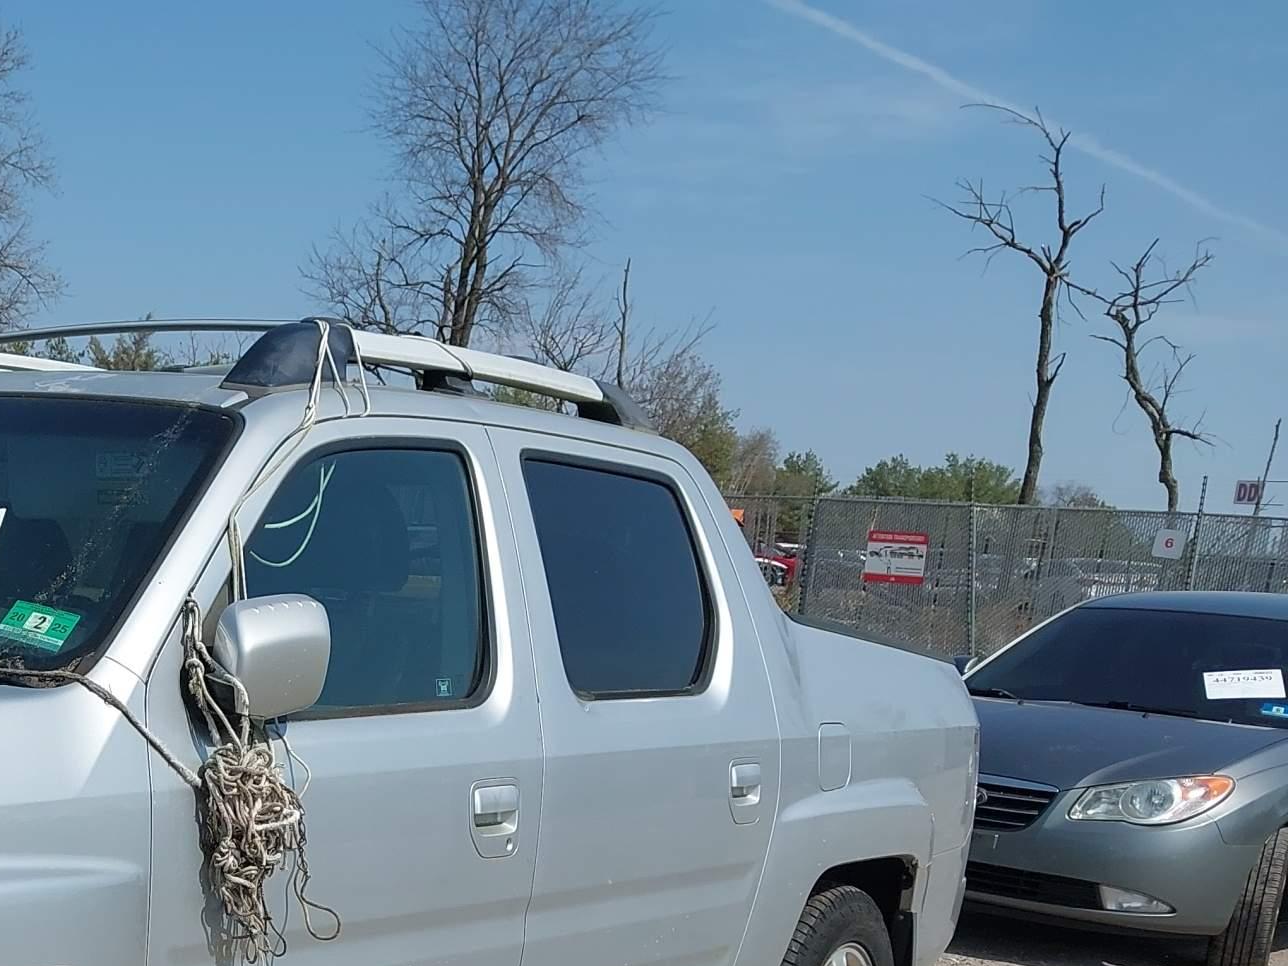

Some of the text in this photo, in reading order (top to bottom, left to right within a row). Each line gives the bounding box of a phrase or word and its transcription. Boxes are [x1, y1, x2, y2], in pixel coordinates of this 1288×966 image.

[1165, 537, 1174, 549] 6
[10, 611, 25, 622] 20
[33, 615, 47, 630] 2
[52, 622, 70, 634] 25
